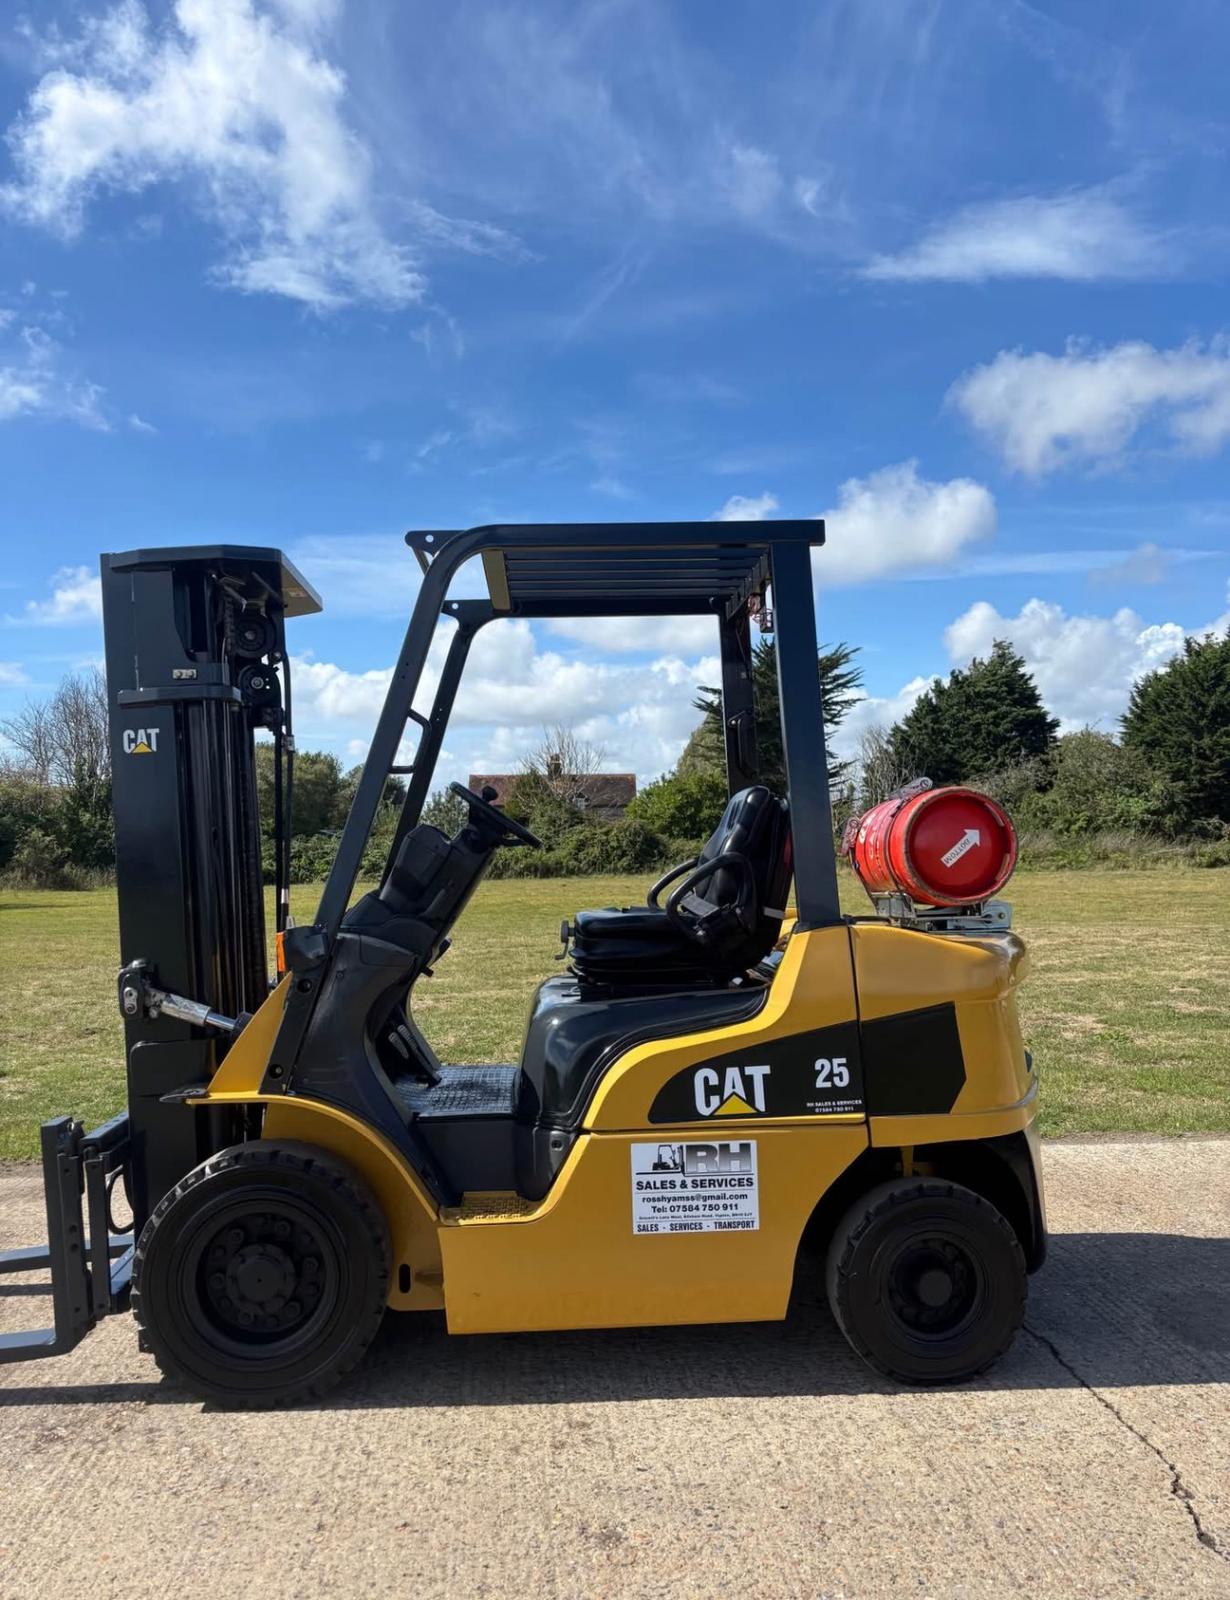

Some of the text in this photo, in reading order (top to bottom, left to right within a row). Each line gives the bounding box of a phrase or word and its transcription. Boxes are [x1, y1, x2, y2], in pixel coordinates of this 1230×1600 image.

[122, 728, 160, 754] CAT
[944, 838, 970, 864] BOTTOM
[814, 1057, 850, 1089] 25
[693, 1065, 771, 1117] CAT
[685, 1142, 752, 1173] RH
[636, 1177, 754, 1191] SALES & SERVICES
[642, 1193, 748, 1204] rosshyamss@gmail.com
[651, 1203, 738, 1213] Tel: 07584 750 911
[637, 1223, 659, 1232] SALES
[669, 1222, 703, 1231] SERVICES
[714, 1220, 755, 1230] TRANSPORT
